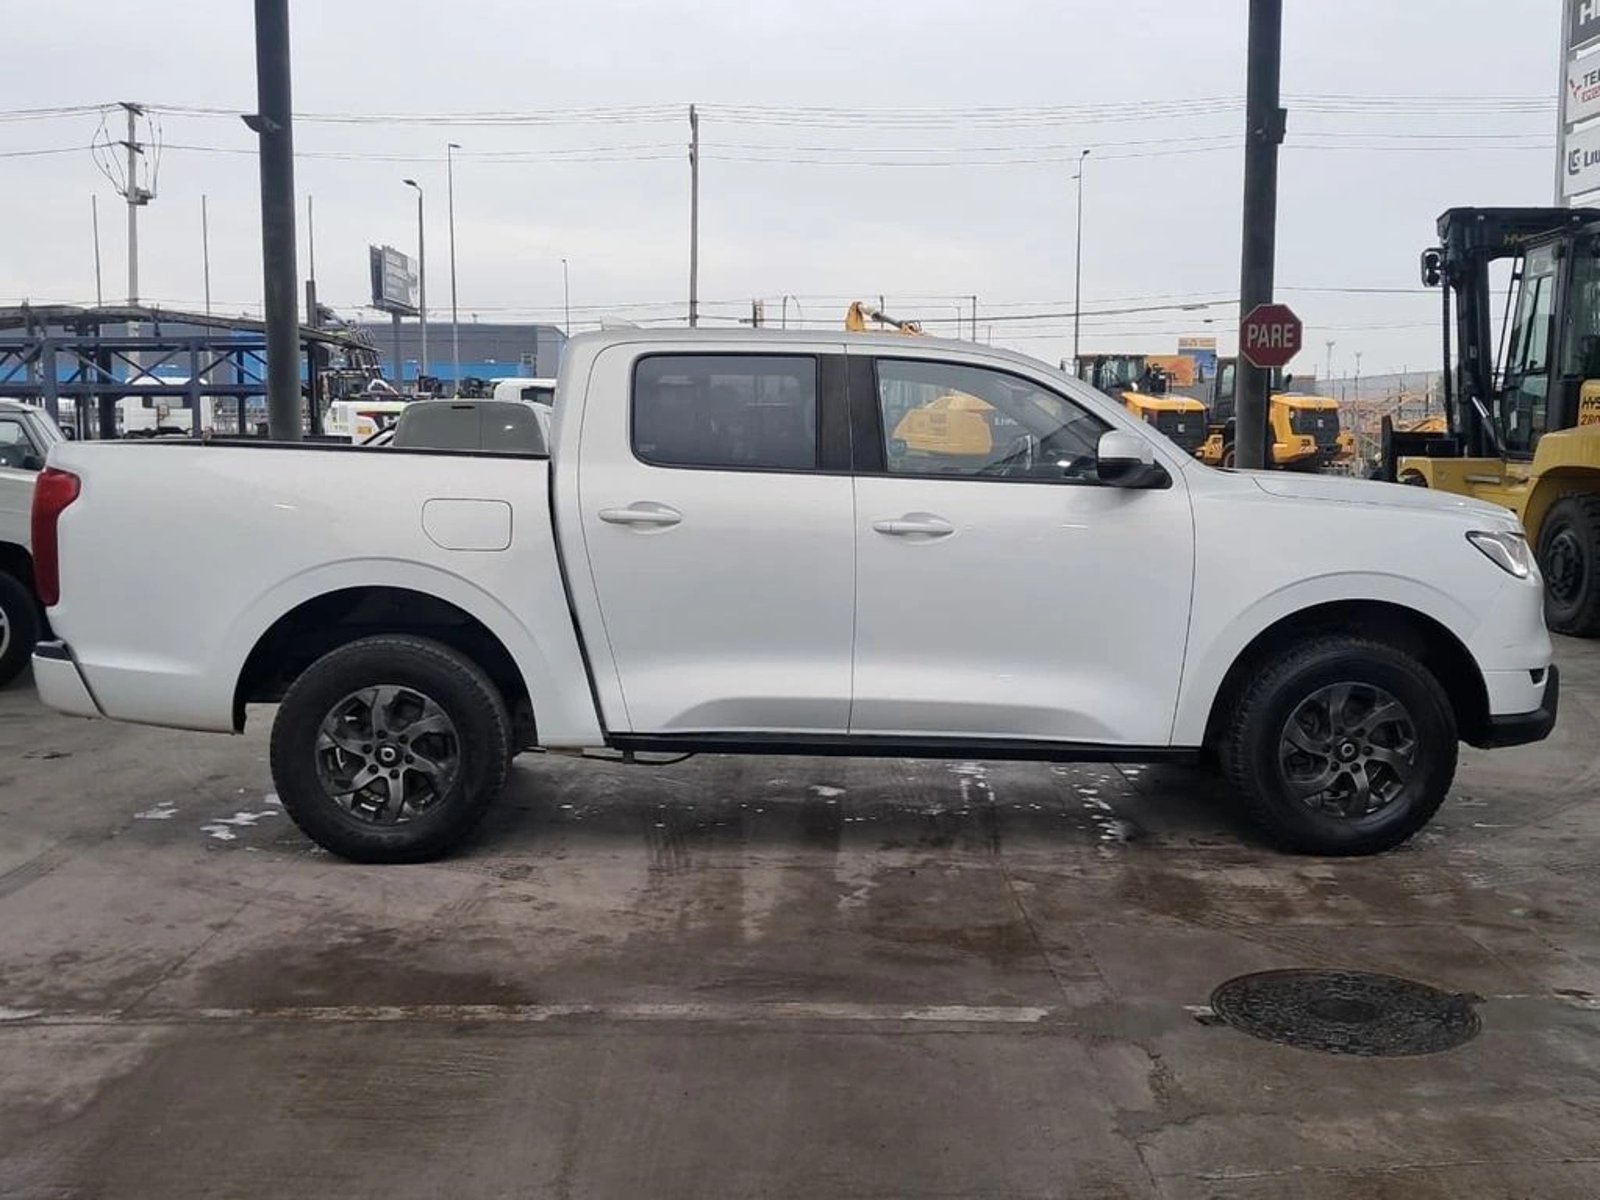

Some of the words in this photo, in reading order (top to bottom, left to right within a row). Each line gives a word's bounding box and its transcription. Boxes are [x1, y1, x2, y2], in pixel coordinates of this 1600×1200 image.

[1579, 0, 1600, 25] H
[1583, 69, 1600, 88] TE
[1247, 323, 1294, 348] PARE
